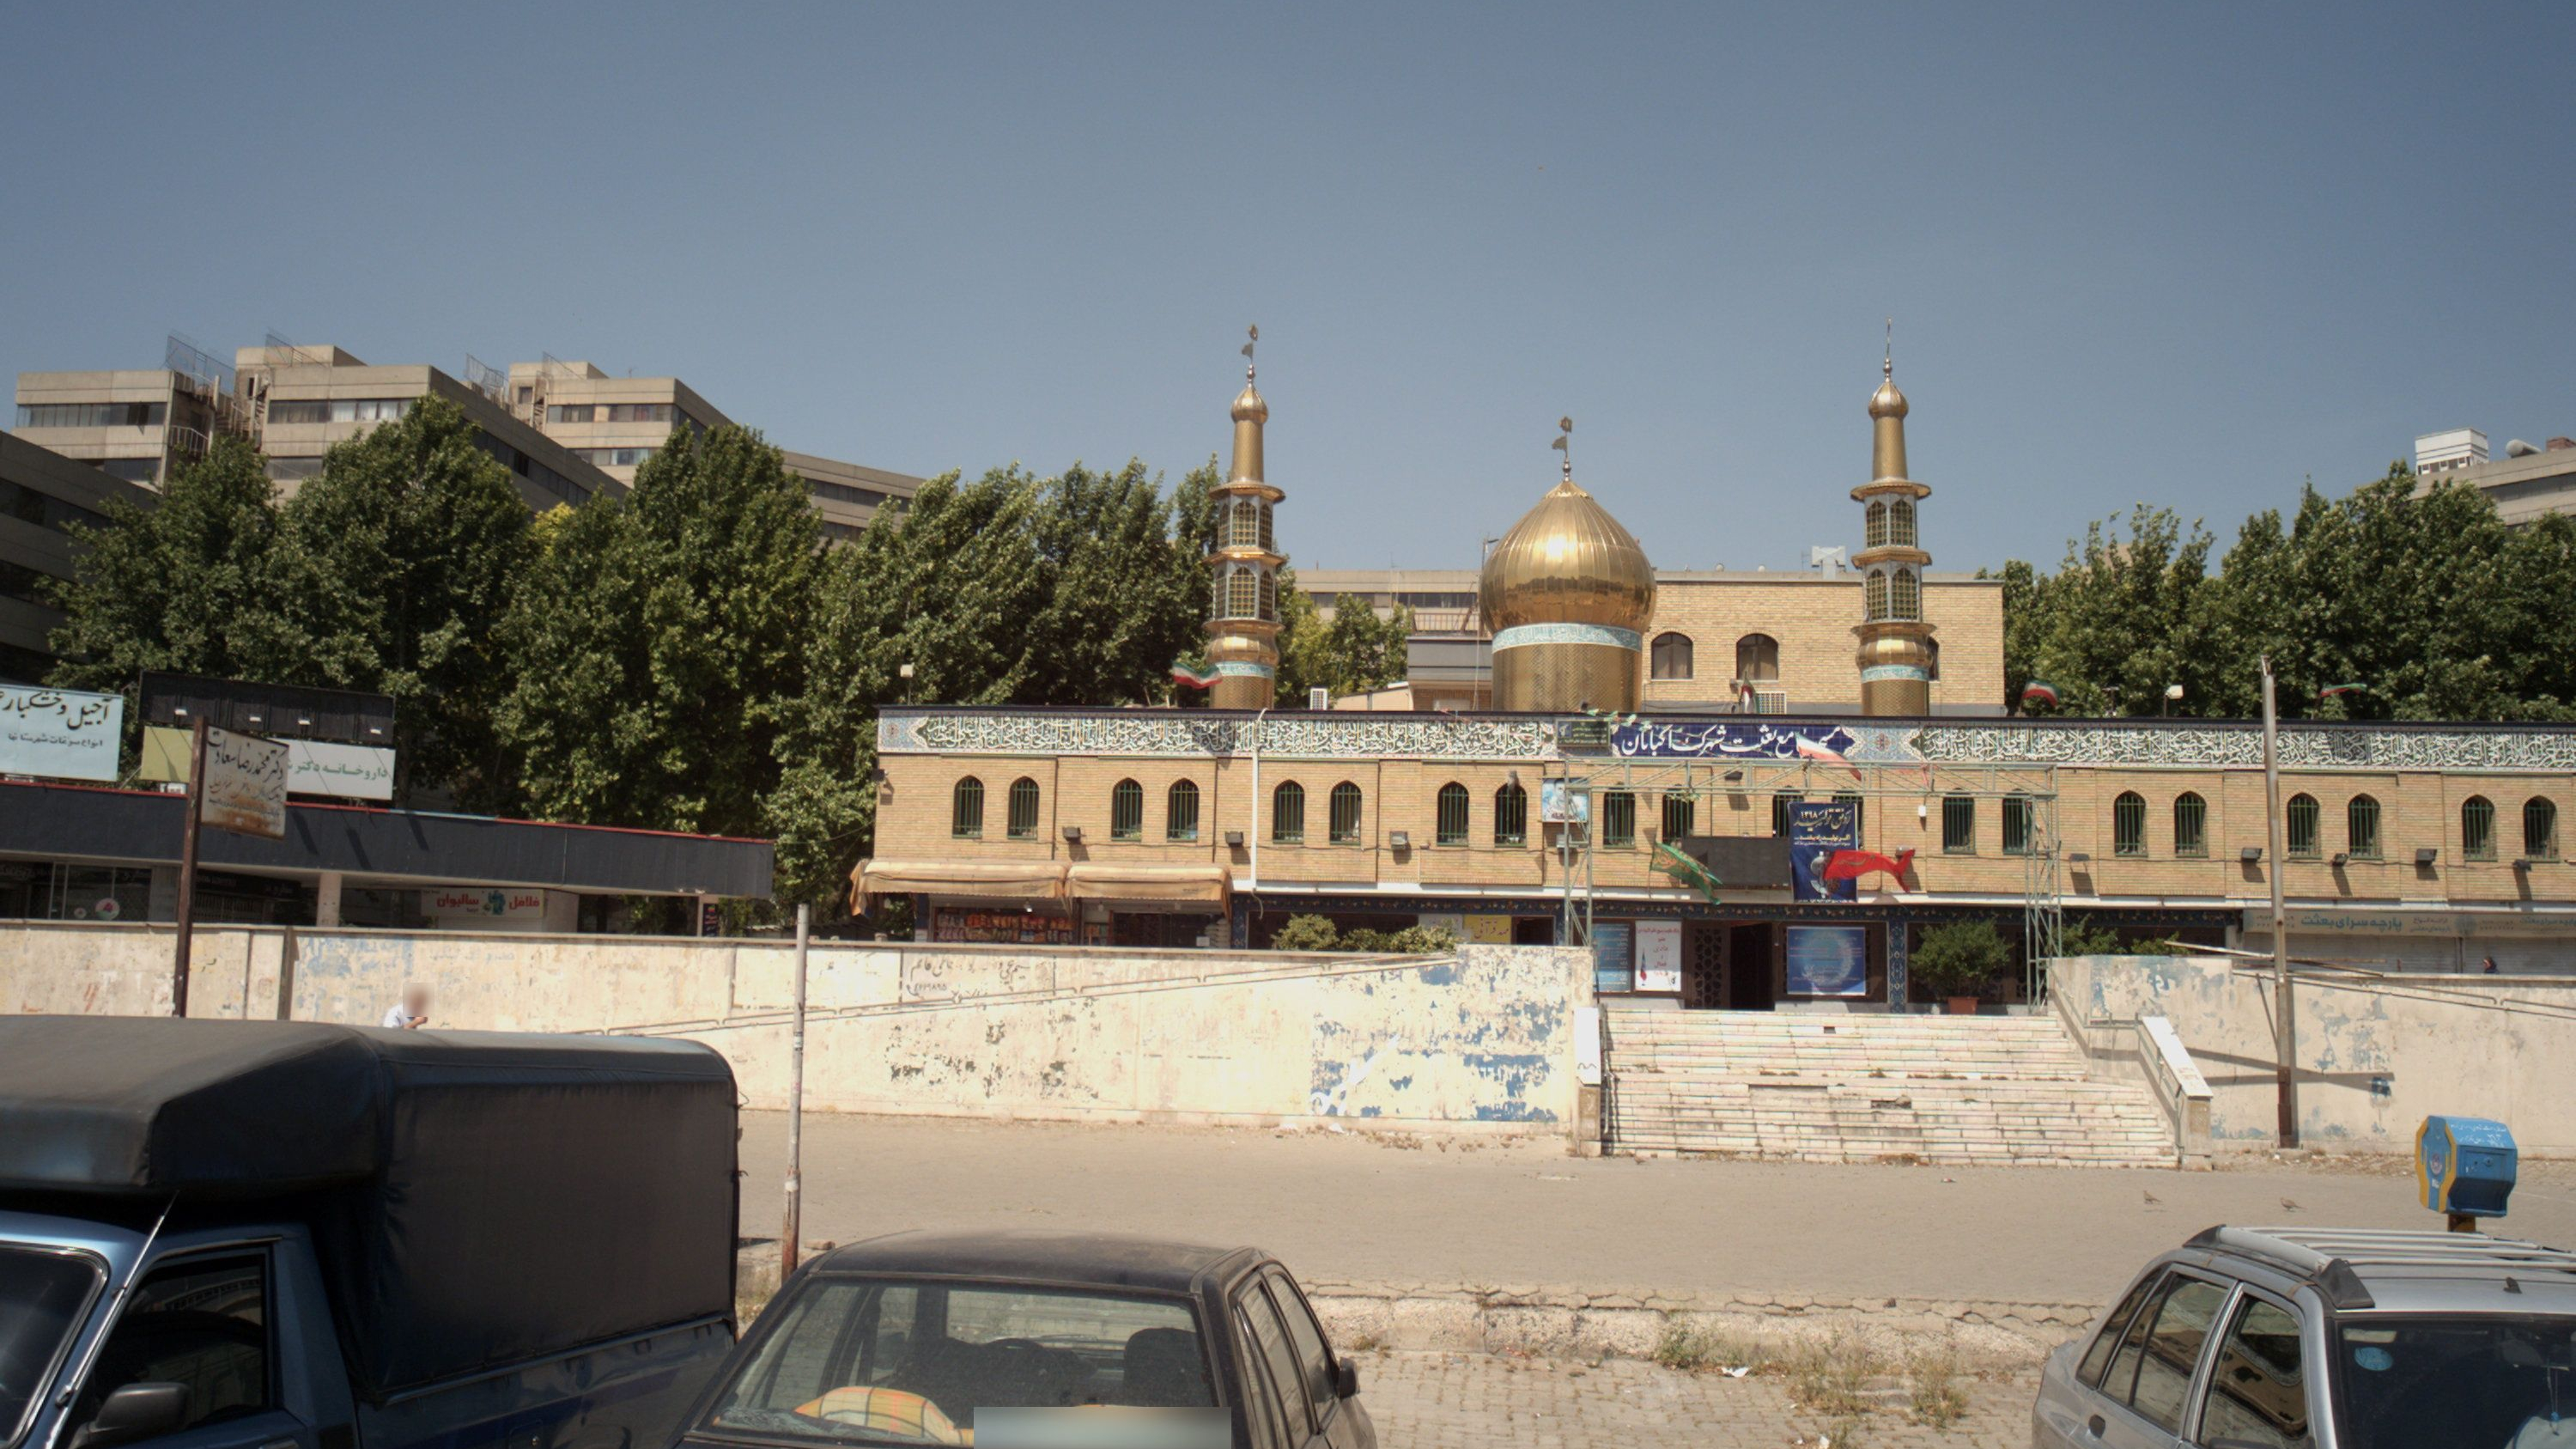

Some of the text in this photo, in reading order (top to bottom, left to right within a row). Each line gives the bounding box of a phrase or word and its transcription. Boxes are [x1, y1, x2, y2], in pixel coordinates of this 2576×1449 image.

[2, 690, 112, 730] آجیل و خشکبار
[50, 735, 81, 747] سوغات
[82, 738, 103, 748] انواع
[1671, 724, 1728, 757] شهرک
[1719, 724, 1778, 753] بعثت
[295, 759, 320, 774] دکتر
[323, 763, 388, 781] داروخانه
[508, 896, 540, 910] فلافل
[2301, 914, 2335, 928] بعثت
[2336, 916, 2368, 930] سرای
[2370, 916, 2402, 931] پارچه
